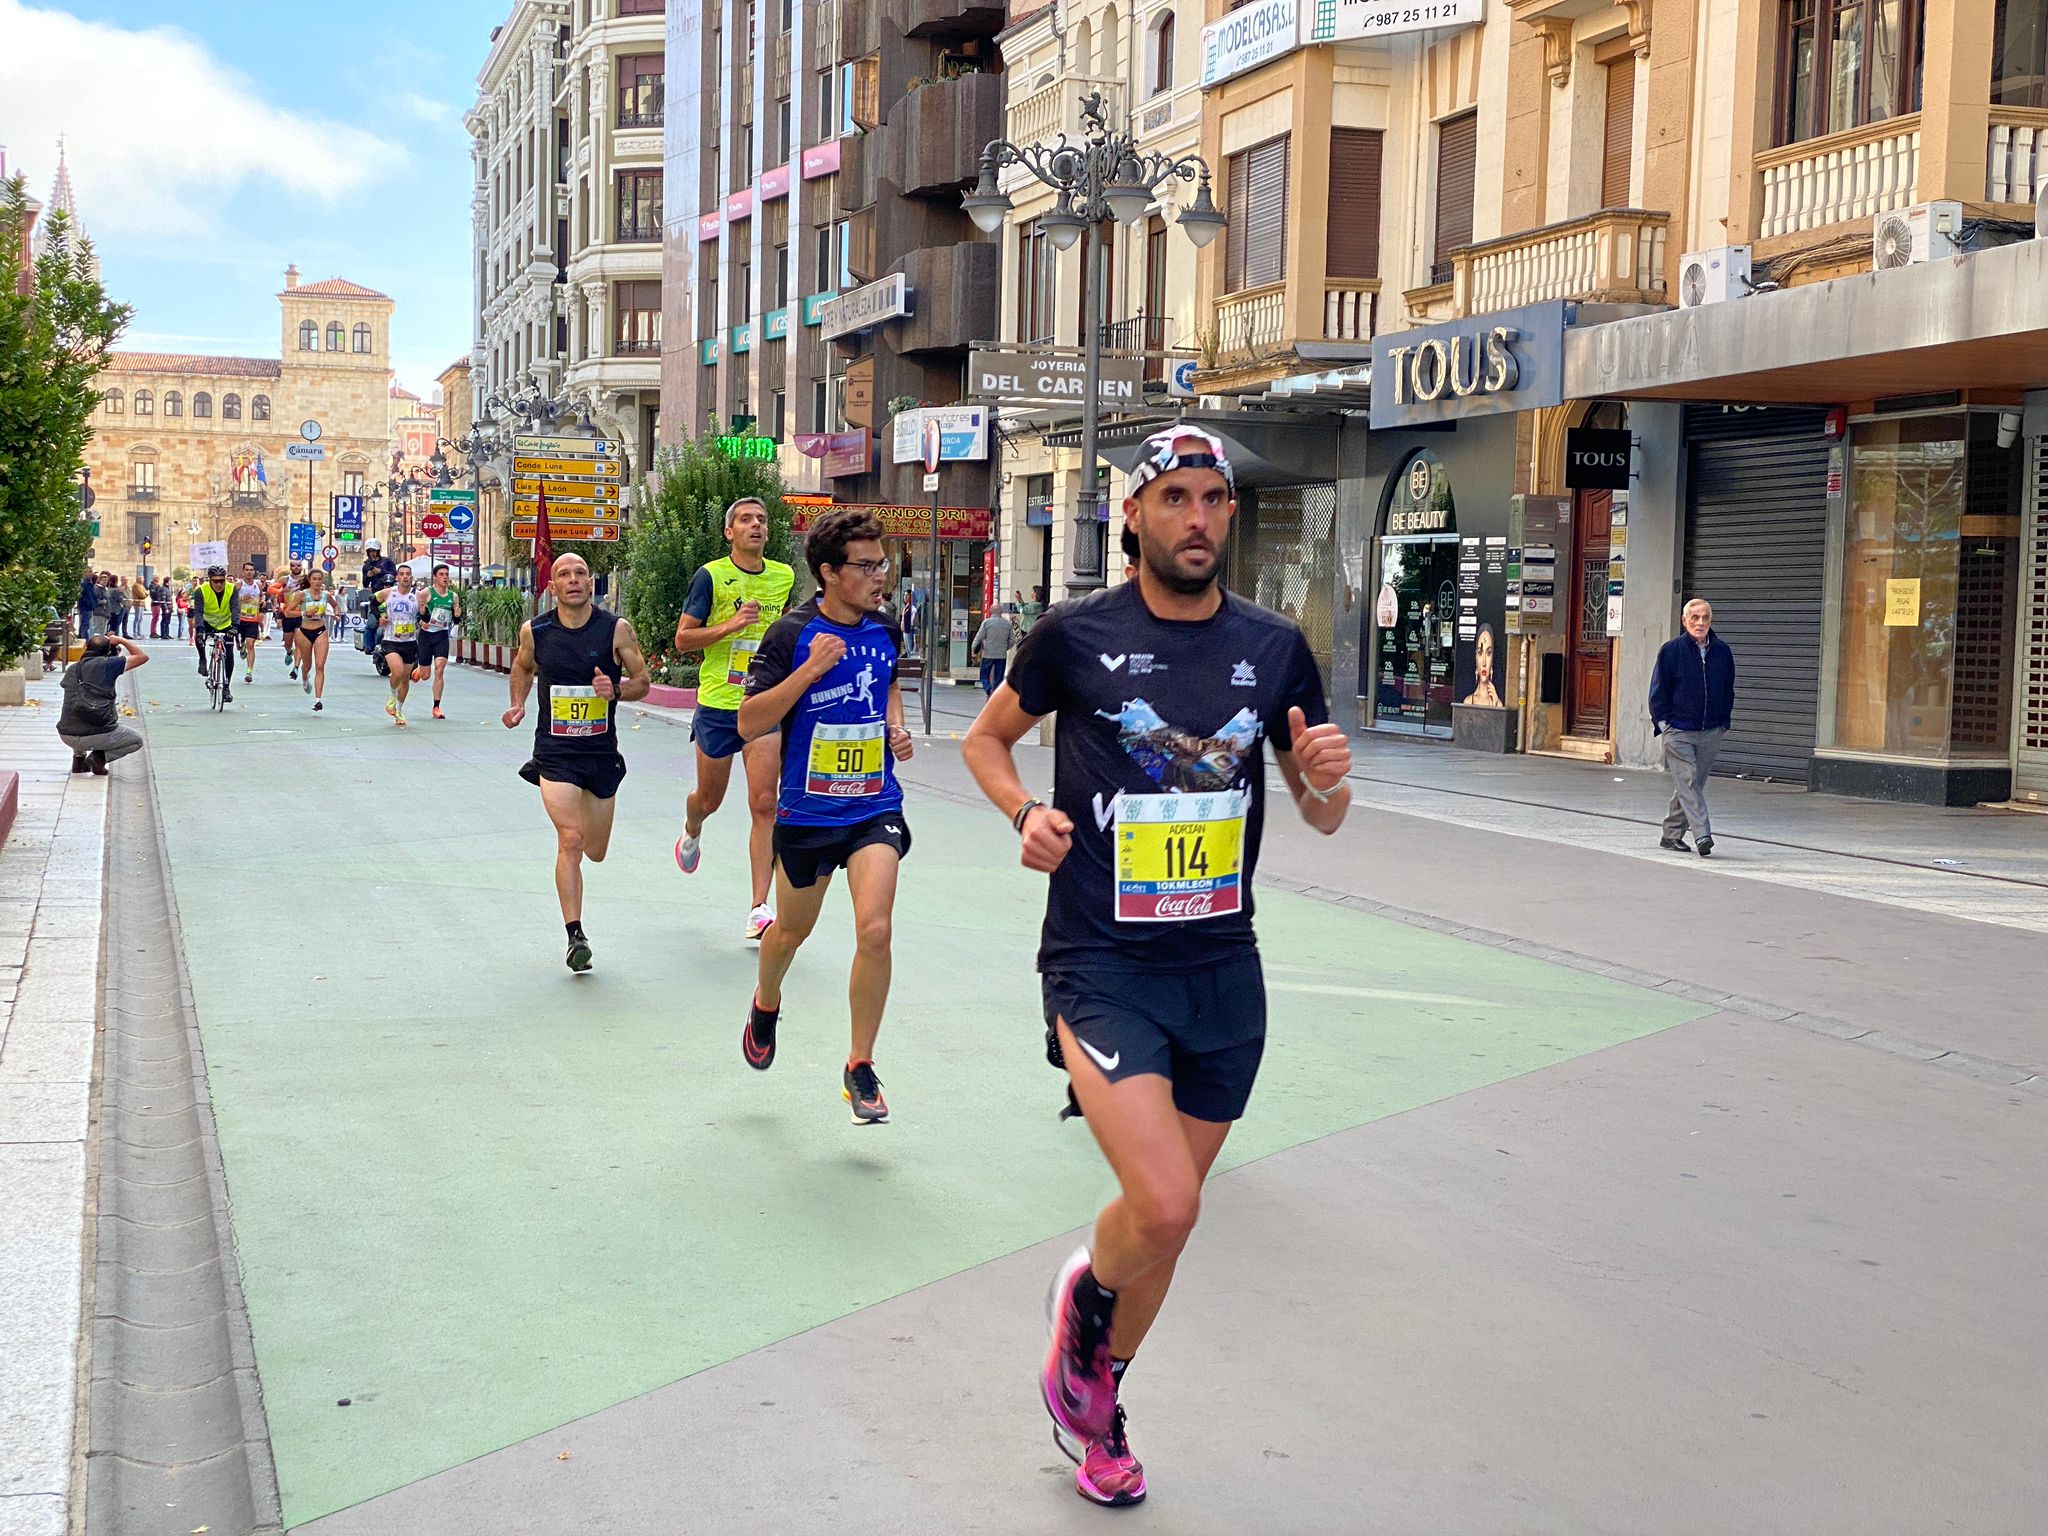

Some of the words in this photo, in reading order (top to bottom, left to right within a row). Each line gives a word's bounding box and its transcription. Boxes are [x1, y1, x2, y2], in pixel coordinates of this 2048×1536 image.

[1375, 12, 1399, 27] 987
[1402, 10, 1420, 22] 25
[1425, 6, 1438, 20] 11
[1443, 3, 1458, 17] 21
[1251, 46, 1259, 60] 25
[1259, 43, 1266, 56] 11
[1266, 40, 1273, 54] 21
[1030, 360, 1086, 372] JOYERIA
[1388, 326, 1519, 405] TOUS
[982, 374, 1025, 392] DEL
[1037, 376, 1133, 398] CAREN
[288, 445, 323, 456] Cámara
[516, 461, 542, 469] Conde
[545, 462, 563, 470] Luna
[1572, 451, 1626, 467] TOUS
[516, 482, 532, 490] Luis
[548, 485, 567, 493] León
[1412, 471, 1426, 489] BE
[1028, 494, 1053, 507] ESTRELLA
[554, 506, 584, 514] Antonio
[866, 507, 968, 521] TANDOORI
[423, 522, 443, 530] STOP
[1392, 512, 1407, 531] BE
[1407, 510, 1447, 531] BEAUTY
[1441, 591, 1453, 609] BE
[810, 682, 854, 705] RUNNING
[570, 703, 589, 720] 97
[837, 748, 864, 773] 90
[1169, 823, 1207, 835] ADRIAN
[1164, 836, 1209, 879] 114
[1156, 879, 1214, 892] 10KMLEON
